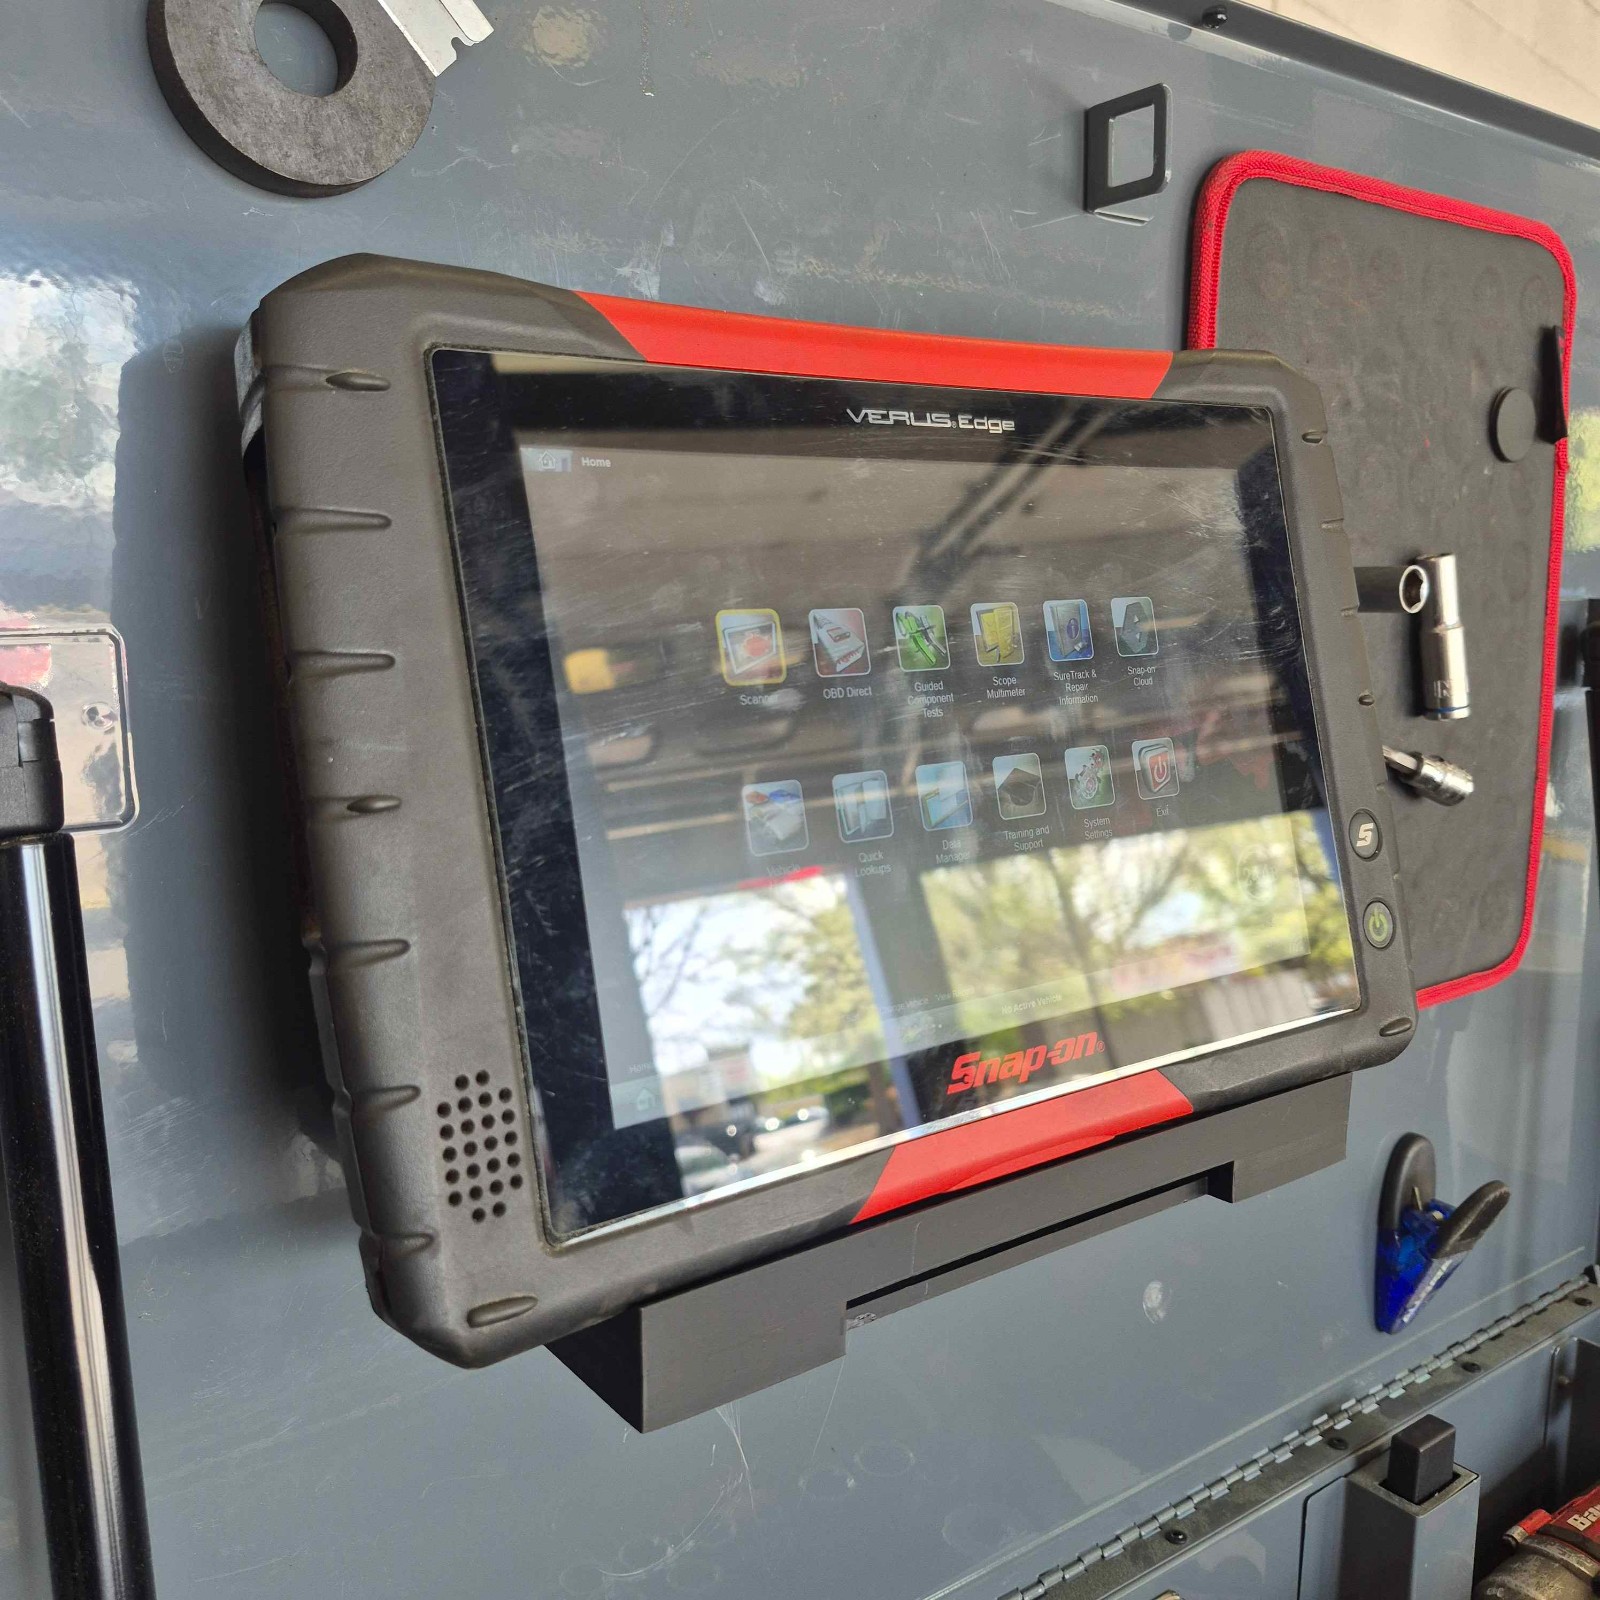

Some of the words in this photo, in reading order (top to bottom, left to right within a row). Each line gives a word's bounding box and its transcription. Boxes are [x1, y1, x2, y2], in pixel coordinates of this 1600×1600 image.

[957, 413, 1015, 434] Edge
[581, 456, 612, 468] Home
[1053, 670, 1090, 681] SureTrack
[1091, 668, 1098, 678] &
[1127, 665, 1156, 677] Snap-on
[914, 680, 944, 692] Guided
[992, 675, 1017, 687] Scope
[1065, 682, 1089, 693] Repair
[1133, 676, 1153, 687] Cloud
[823, 688, 845, 701] OBD
[846, 685, 873, 698] Direct
[986, 687, 1026, 700] Multimeter
[922, 707, 944, 718] Tests
[1083, 816, 1111, 829] System
[1003, 826, 1033, 841] Training
[1035, 824, 1050, 836] and
[1084, 828, 1113, 841] Settings
[1014, 838, 1044, 852] Support
[858, 850, 884, 863] Quick
[854, 862, 893, 878] Lookups
[1001, 1004, 1013, 1016] No
[947, 1031, 1098, 1095] Snap-on
